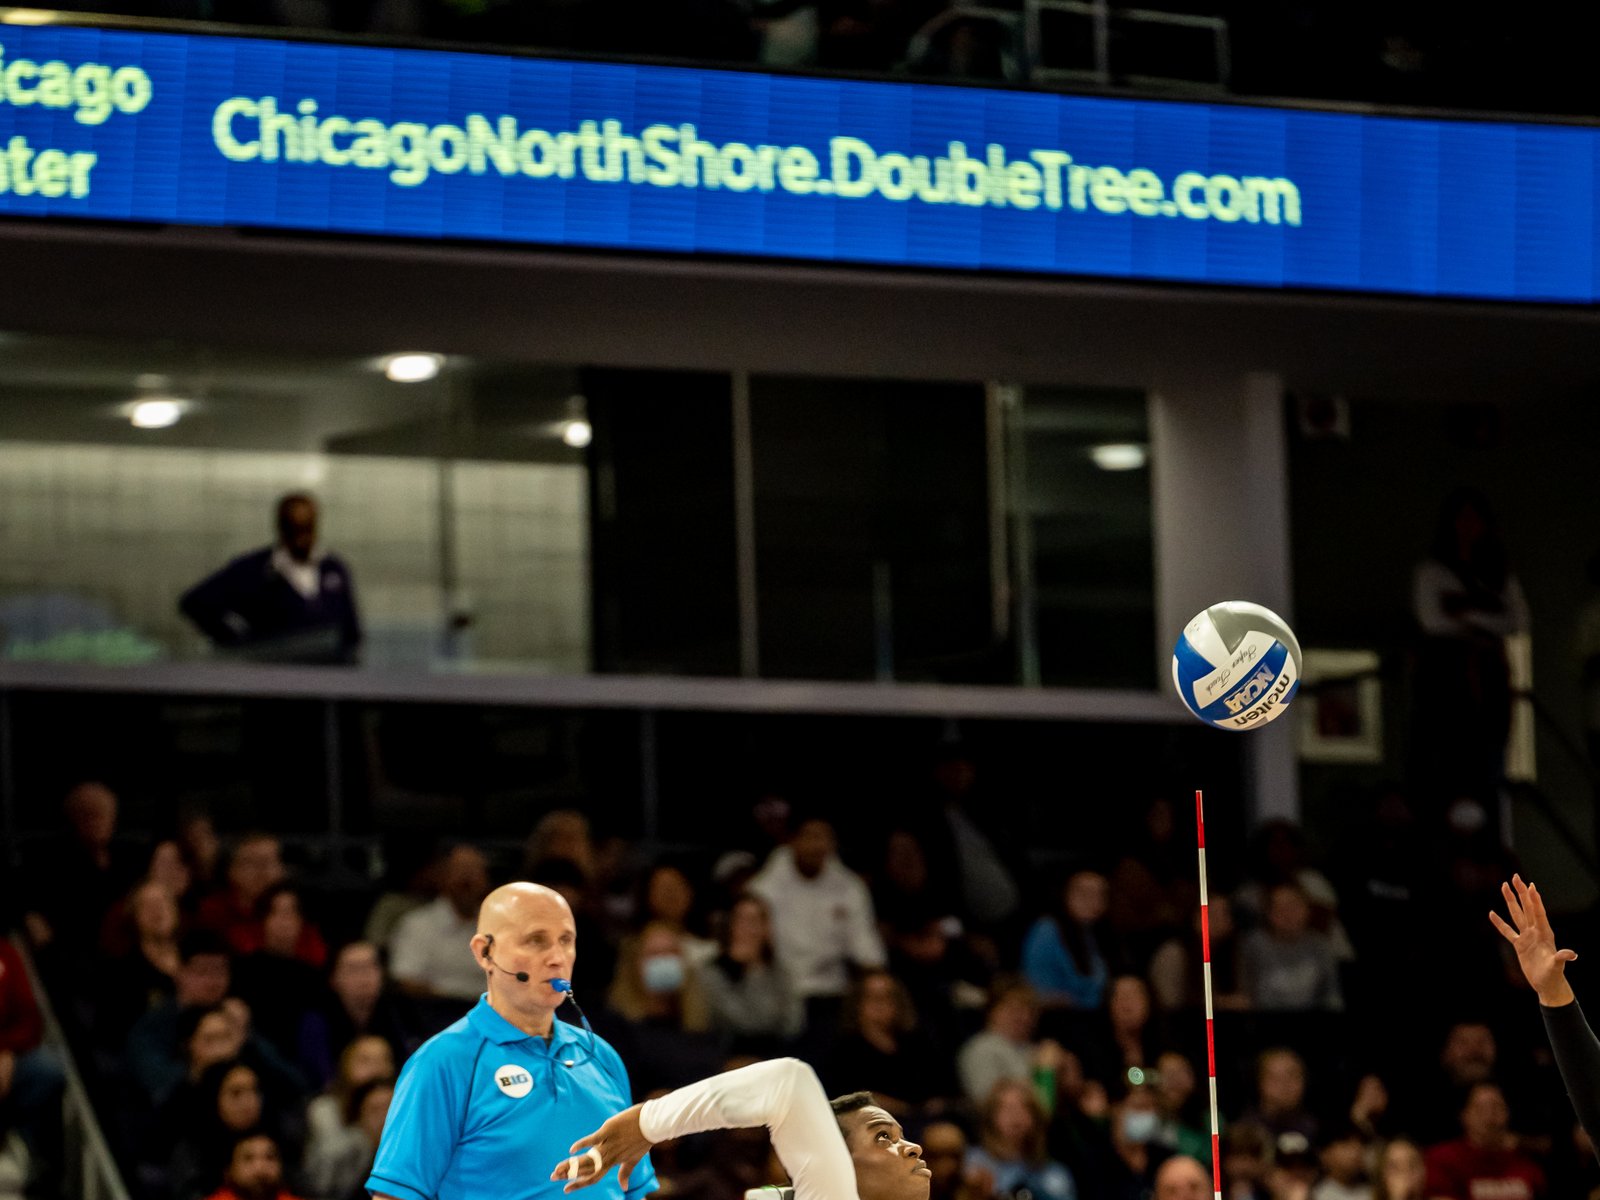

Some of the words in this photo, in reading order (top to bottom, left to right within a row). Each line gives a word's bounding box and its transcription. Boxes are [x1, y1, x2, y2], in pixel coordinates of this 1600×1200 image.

[212, 96, 1301, 226] ChicagoNorthShore.DoubleTree.com
[1223, 662, 1275, 715] NCAA
[1234, 673, 1290, 726] molten
